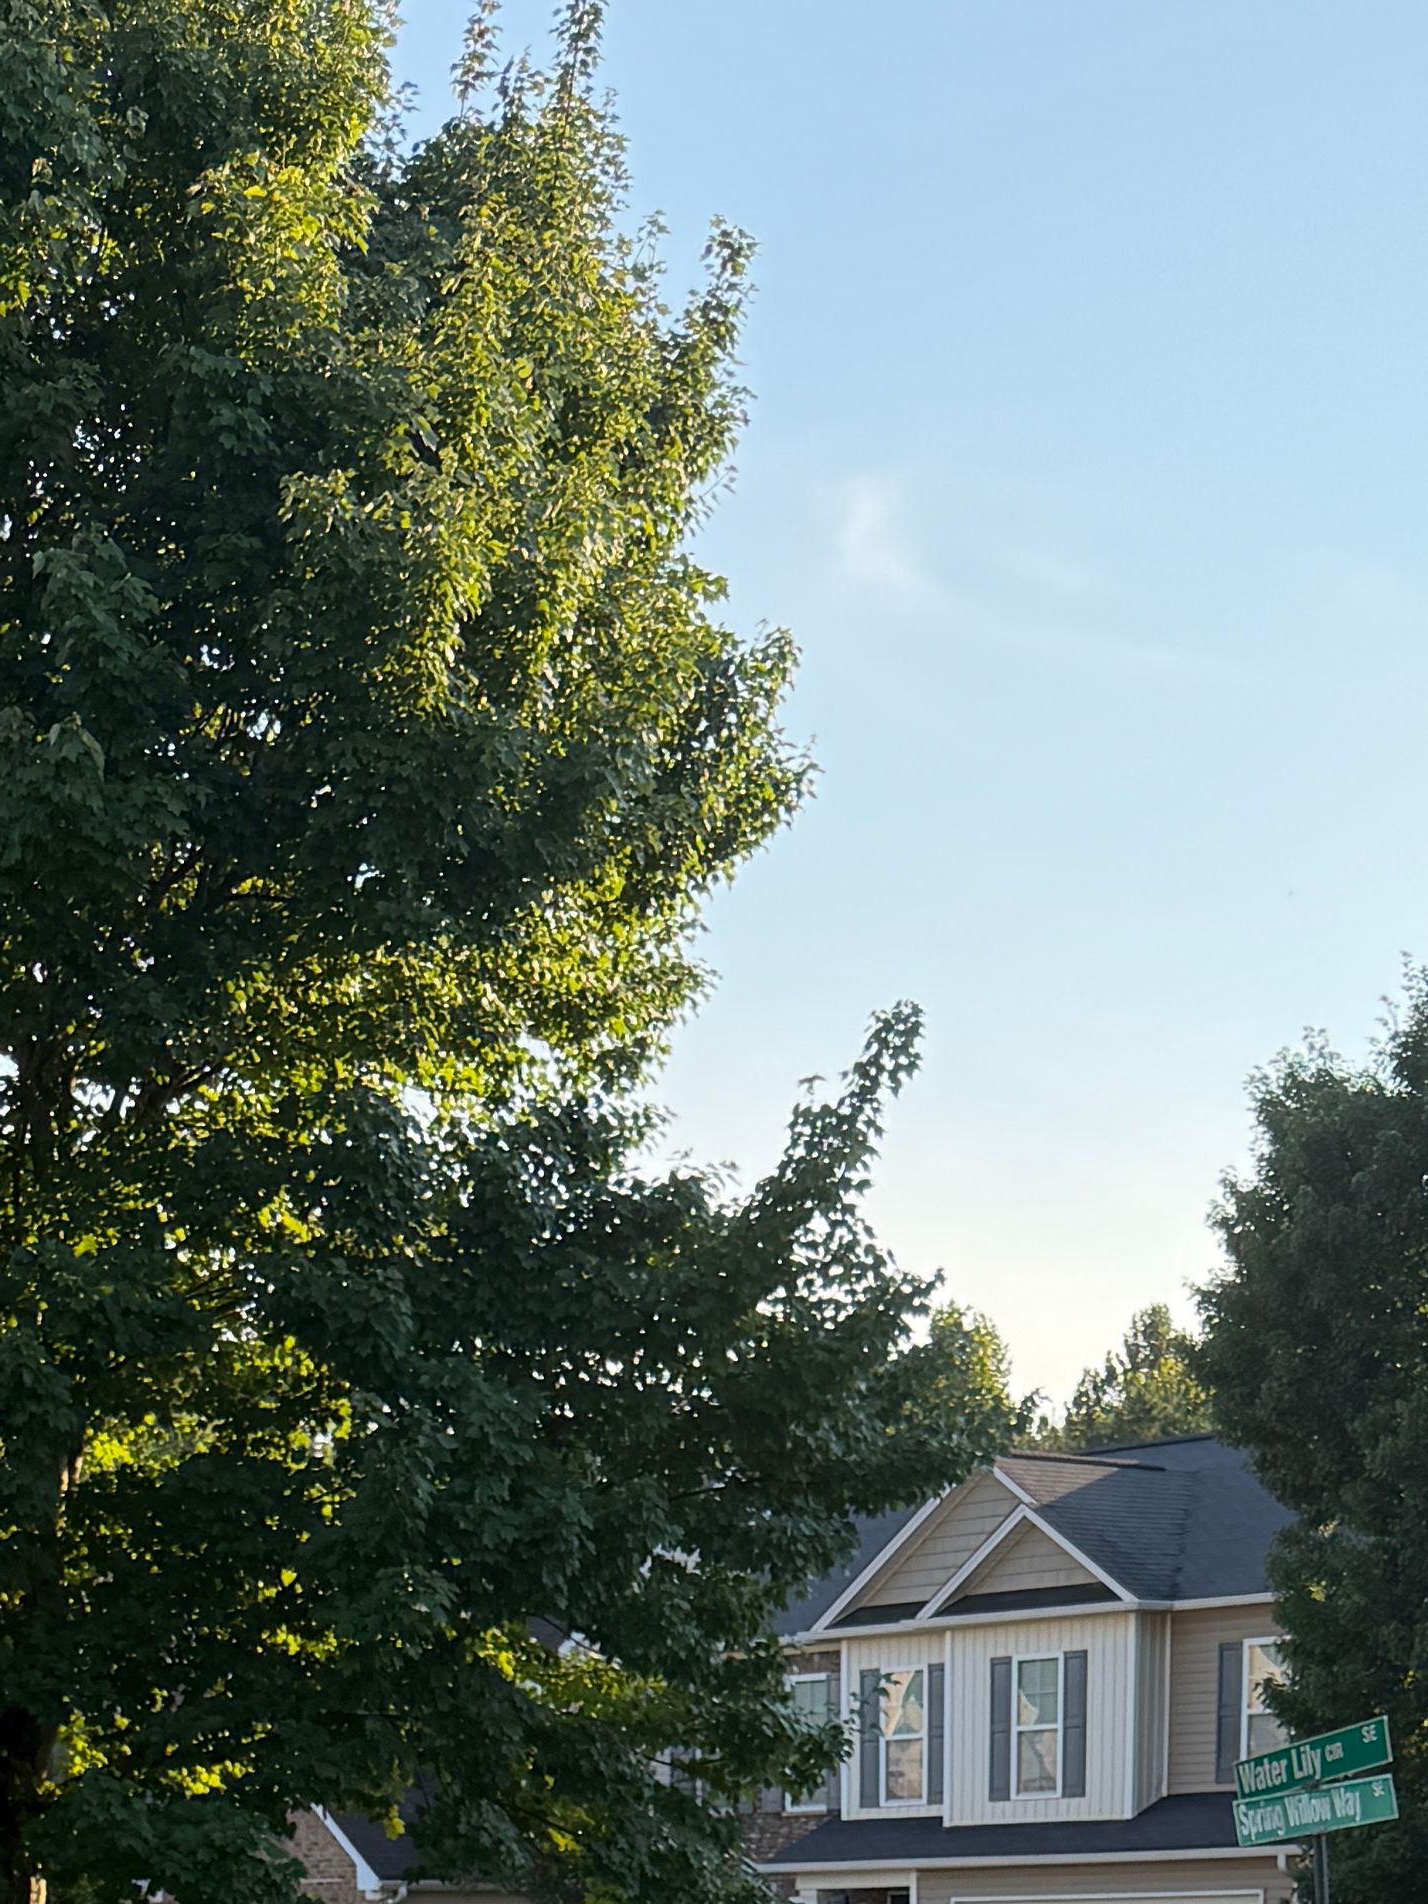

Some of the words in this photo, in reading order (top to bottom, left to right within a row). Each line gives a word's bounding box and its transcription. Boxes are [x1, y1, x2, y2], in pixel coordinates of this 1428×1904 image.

[1238, 1758, 1288, 1794] Water
[1291, 1744, 1321, 1780] Lily
[1361, 1724, 1378, 1743] SE
[1238, 1801, 1285, 1840] Spring
[1284, 1792, 1331, 1827] Willow
[1330, 1787, 1361, 1821] Way
